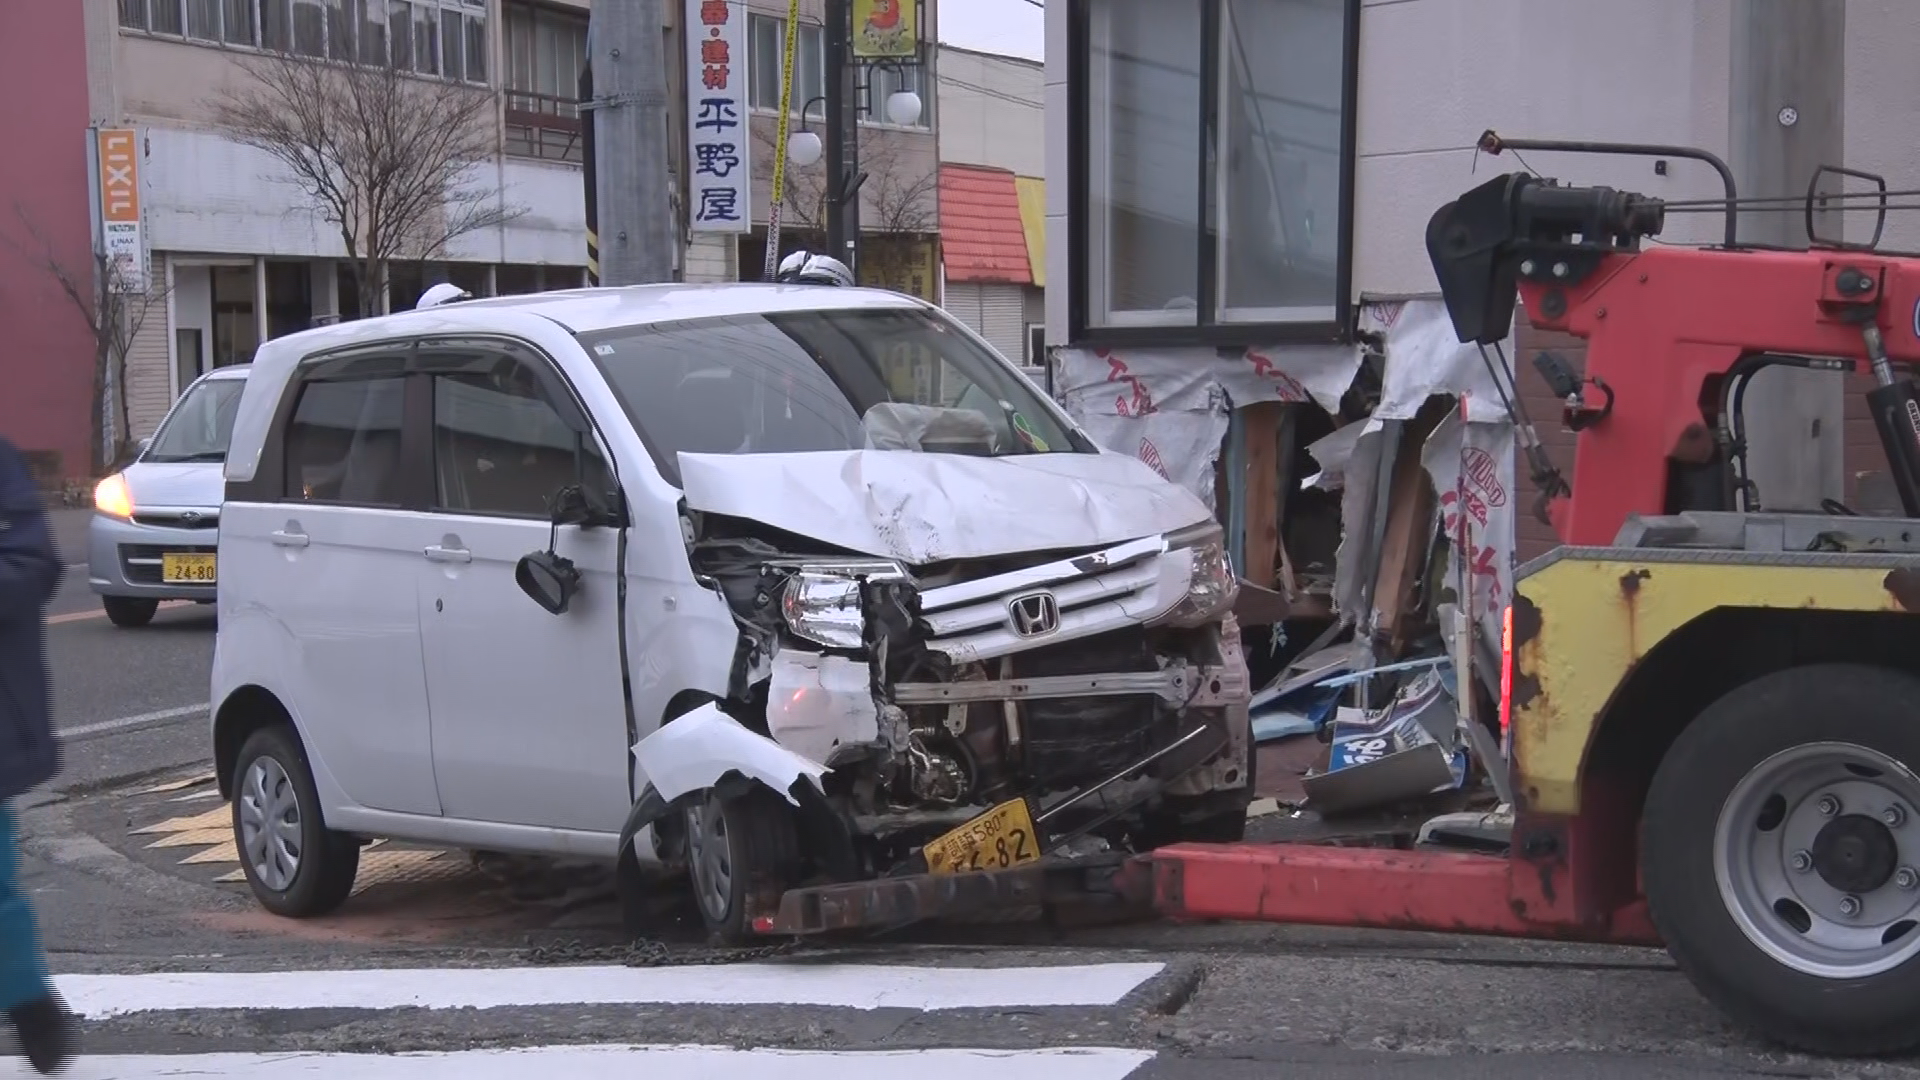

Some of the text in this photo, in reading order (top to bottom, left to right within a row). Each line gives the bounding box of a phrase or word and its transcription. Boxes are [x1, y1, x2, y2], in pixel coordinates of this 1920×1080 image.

[106, 137, 132, 214] LIXIL
[695, 98, 740, 222] 平野屋
[175, 565, 214, 580] 24-80
[973, 815, 1001, 842] 580
